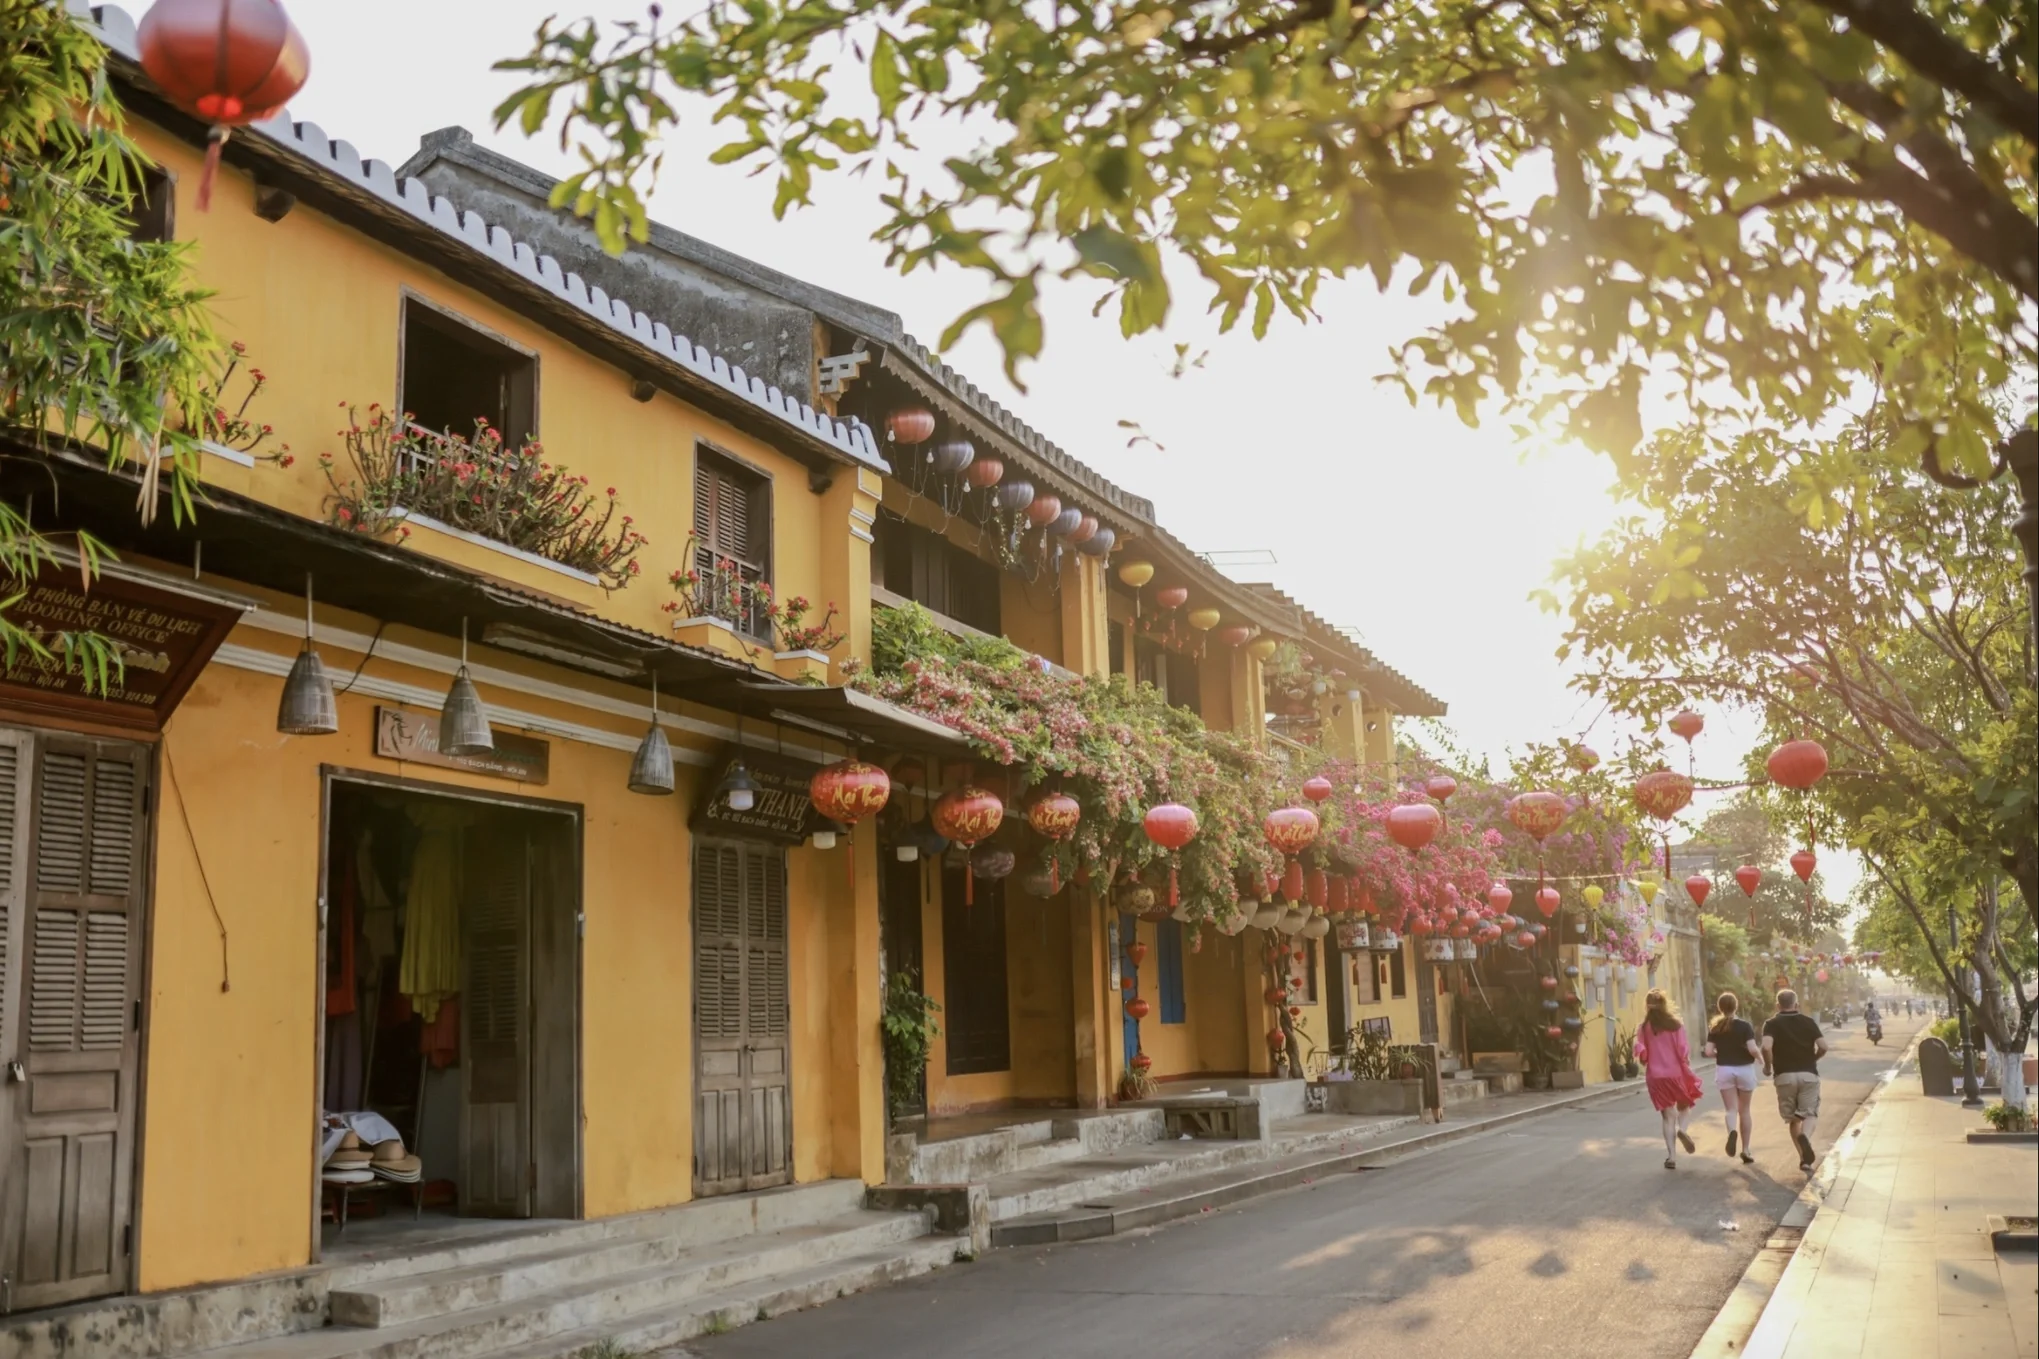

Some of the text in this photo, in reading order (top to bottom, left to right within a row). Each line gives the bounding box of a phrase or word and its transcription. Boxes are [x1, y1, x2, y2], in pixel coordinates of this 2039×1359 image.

[14, 600, 168, 644] BOOKING OFFICE
[146, 613, 168, 627] DU
[755, 788, 811, 821] THANH
